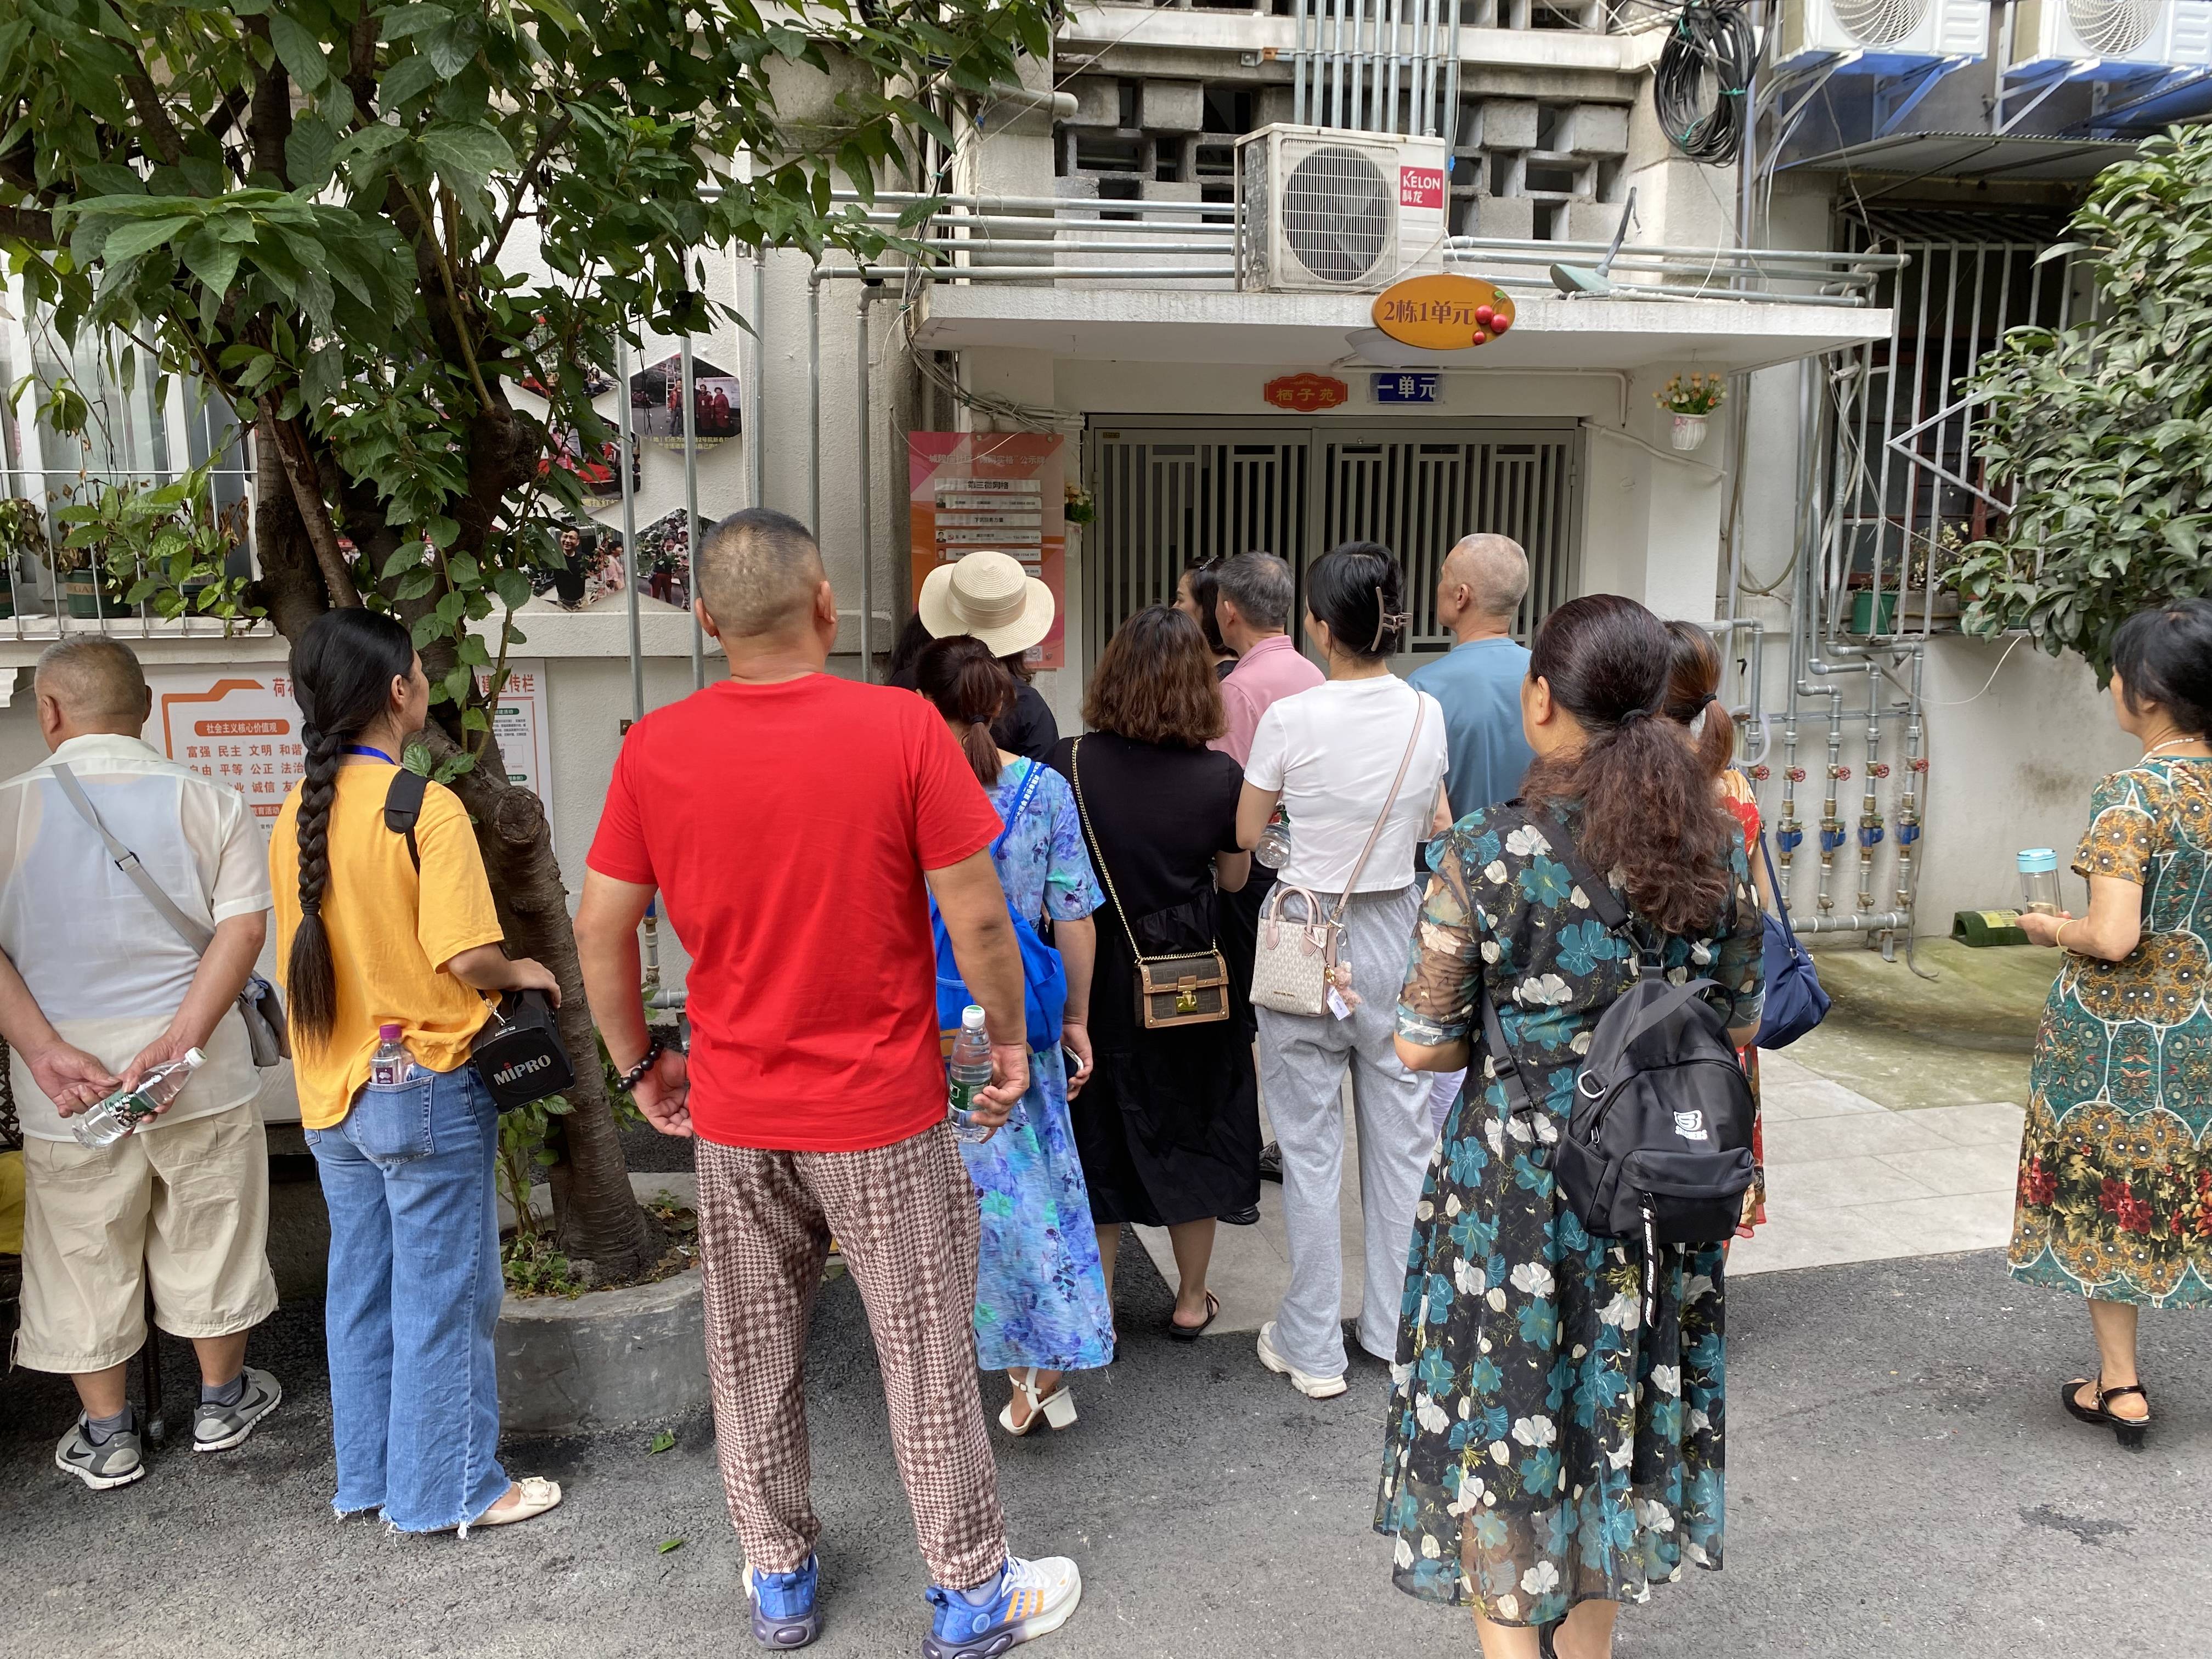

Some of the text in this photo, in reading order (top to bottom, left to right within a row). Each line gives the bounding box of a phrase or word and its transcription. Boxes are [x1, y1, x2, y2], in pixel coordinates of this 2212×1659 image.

[1403, 171, 1440, 190] KELON
[1402, 189, 1423, 204] 科龙
[1383, 300, 1474, 325] 2栋1单元
[1377, 376, 1436, 398] 一单元
[967, 481, 1009, 489] 第三微网格
[206, 723, 278, 734] 社会主义核心价值观
[187, 743, 303, 758] 富强 民主 文明 和谐
[220, 763, 243, 776] 平等
[250, 763, 274, 775] 公正
[281, 761, 304, 775] 法治
[252, 781, 275, 793] 诚信
